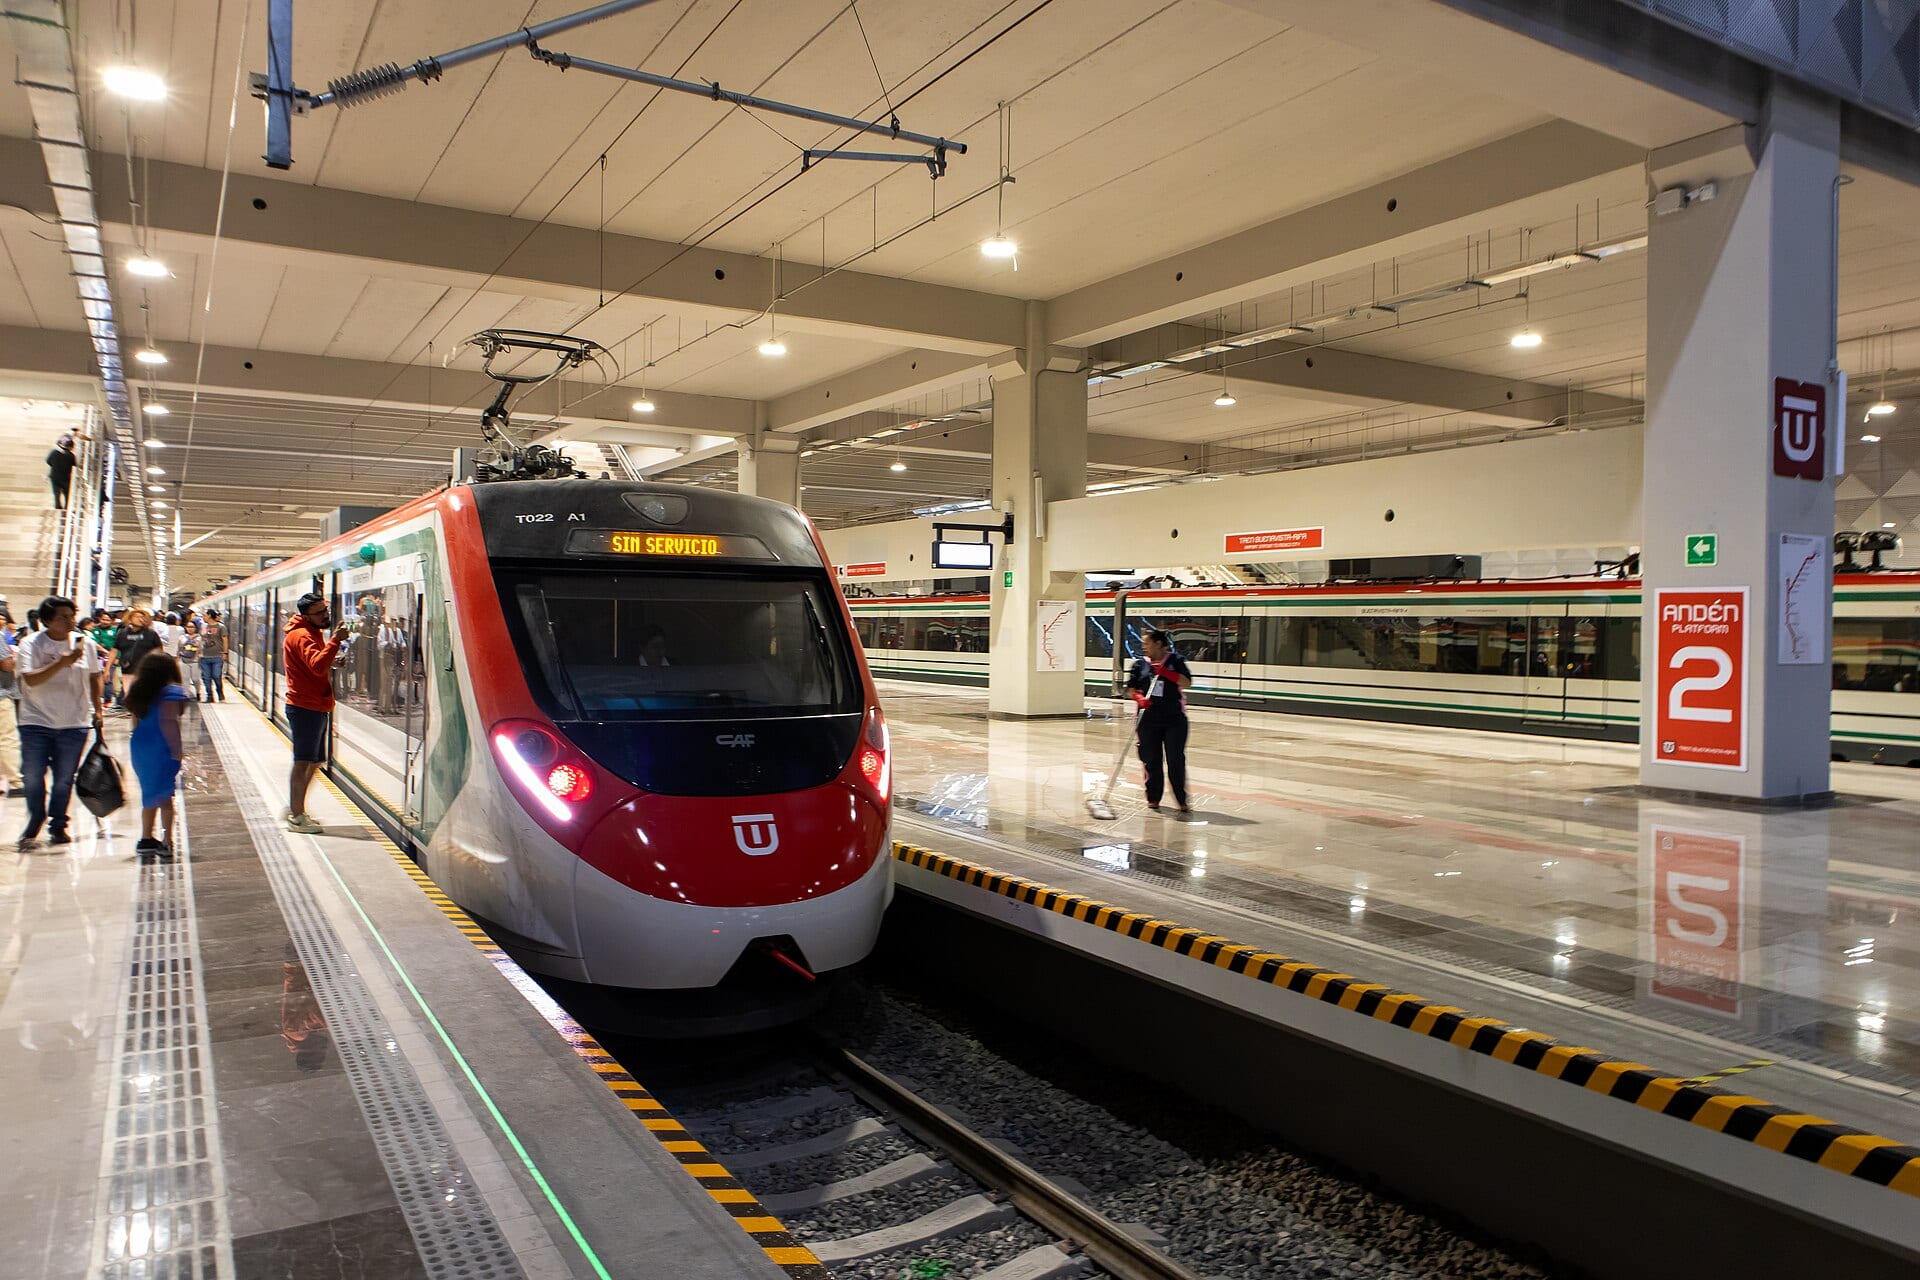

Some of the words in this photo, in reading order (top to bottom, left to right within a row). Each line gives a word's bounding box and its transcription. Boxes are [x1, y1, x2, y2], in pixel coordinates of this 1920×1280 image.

[515, 513, 554, 524] T022
[567, 512, 586, 521] A1
[612, 536, 640, 553] SIN
[646, 537, 718, 555] SERVICIO
[1663, 598, 1739, 622] ANDÉN
[1671, 623, 1730, 635] PLATFORM
[1668, 645, 1733, 723] 2
[715, 734, 756, 748] CAF
